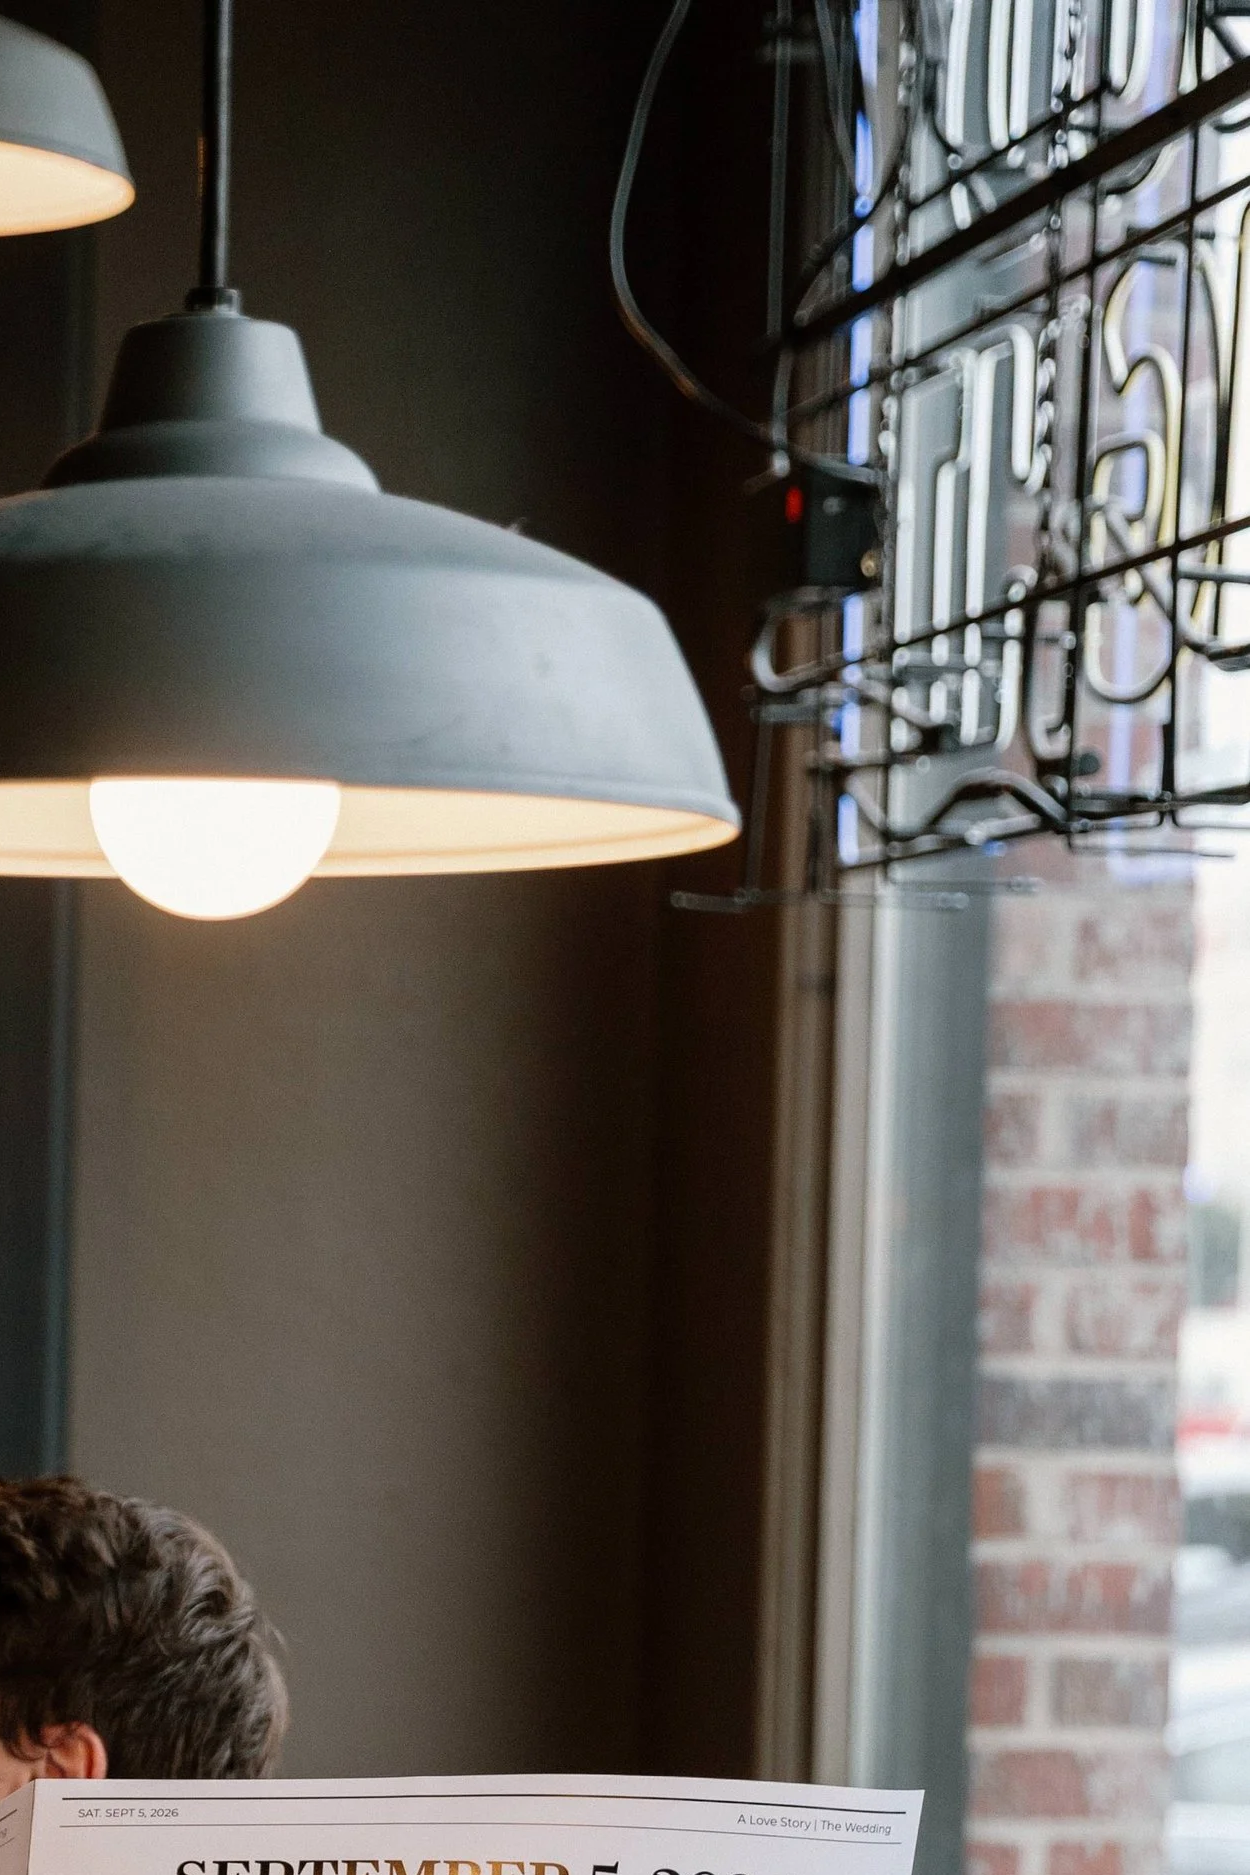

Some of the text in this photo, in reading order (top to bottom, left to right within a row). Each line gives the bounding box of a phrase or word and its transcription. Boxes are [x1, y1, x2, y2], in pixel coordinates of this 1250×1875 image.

[105, 1808, 136, 1818] SEPT
[150, 1808, 179, 1818] 2026
[737, 1814, 746, 1824] A
[750, 1815, 778, 1827] Love
[781, 1817, 811, 1830] Story
[821, 1820, 842, 1831] The
[845, 1822, 892, 1837] Wedding
